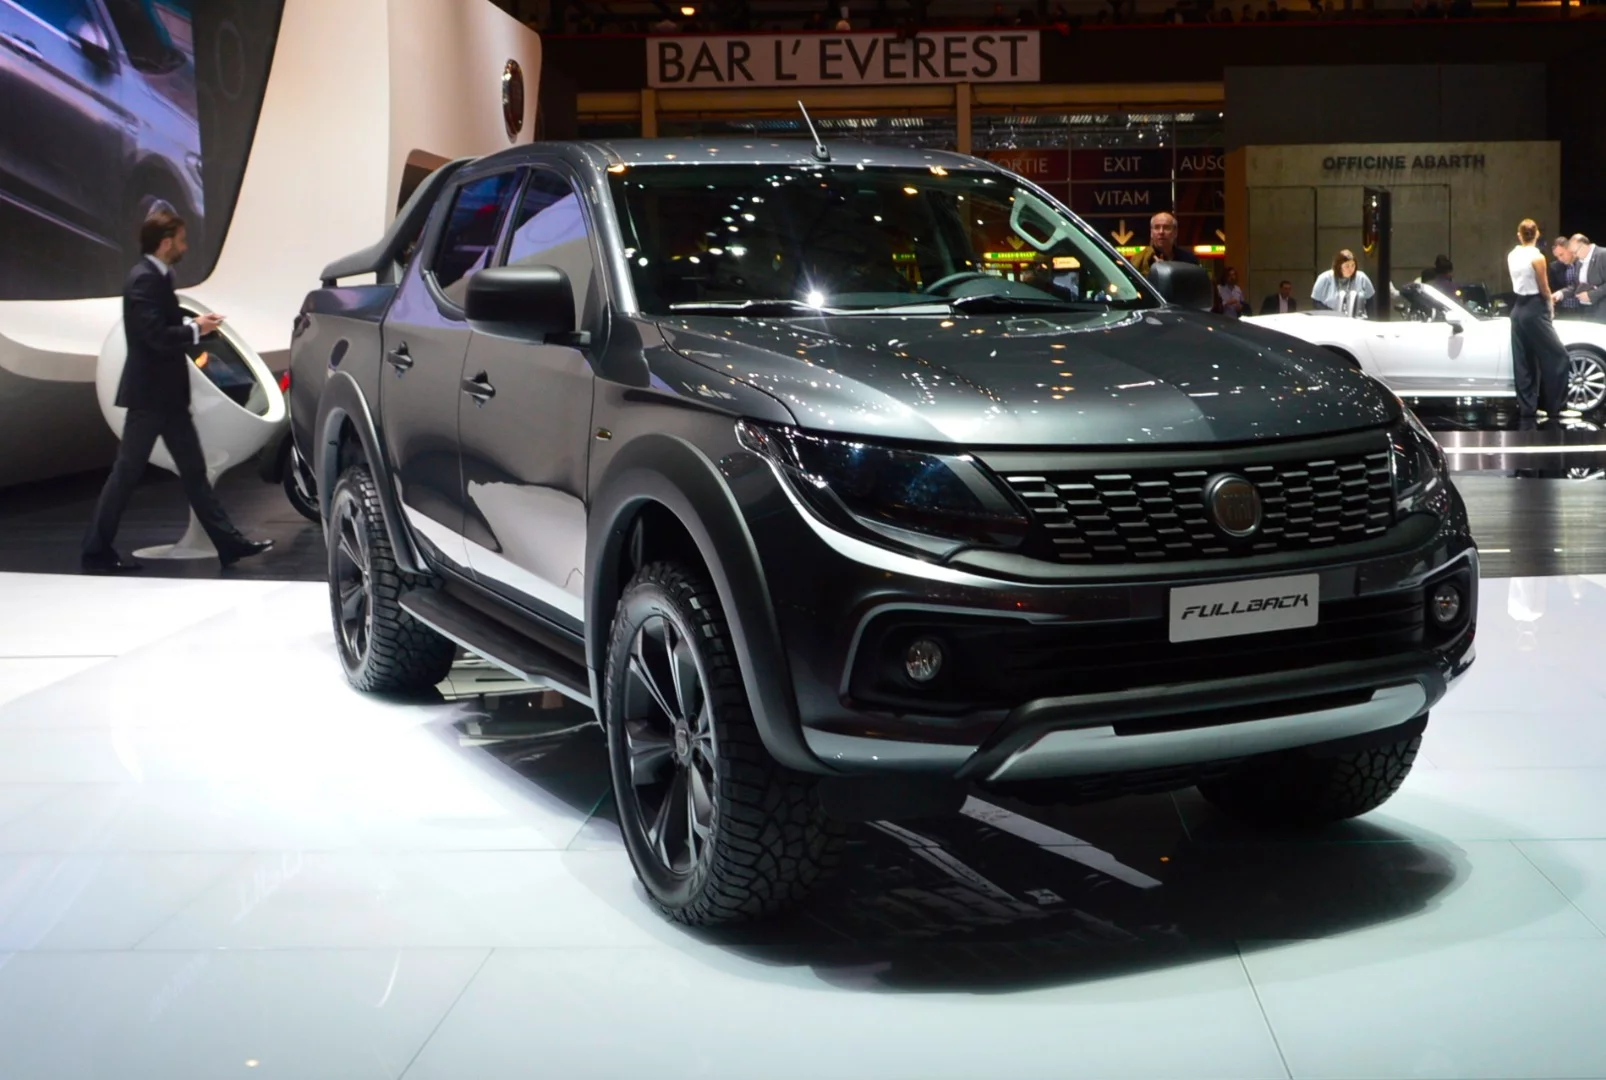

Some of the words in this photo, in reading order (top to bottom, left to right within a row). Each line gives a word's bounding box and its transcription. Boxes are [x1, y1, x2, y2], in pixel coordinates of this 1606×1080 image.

[658, 40, 755, 83] BAR
[988, 157, 1049, 174] ORTIE
[1103, 156, 1142, 172] EXIT
[1323, 155, 1406, 170] OFFICINE
[1412, 154, 1485, 170] ABARTH
[1094, 190, 1150, 206] VITAM
[1181, 593, 1309, 620] FULLBACK
